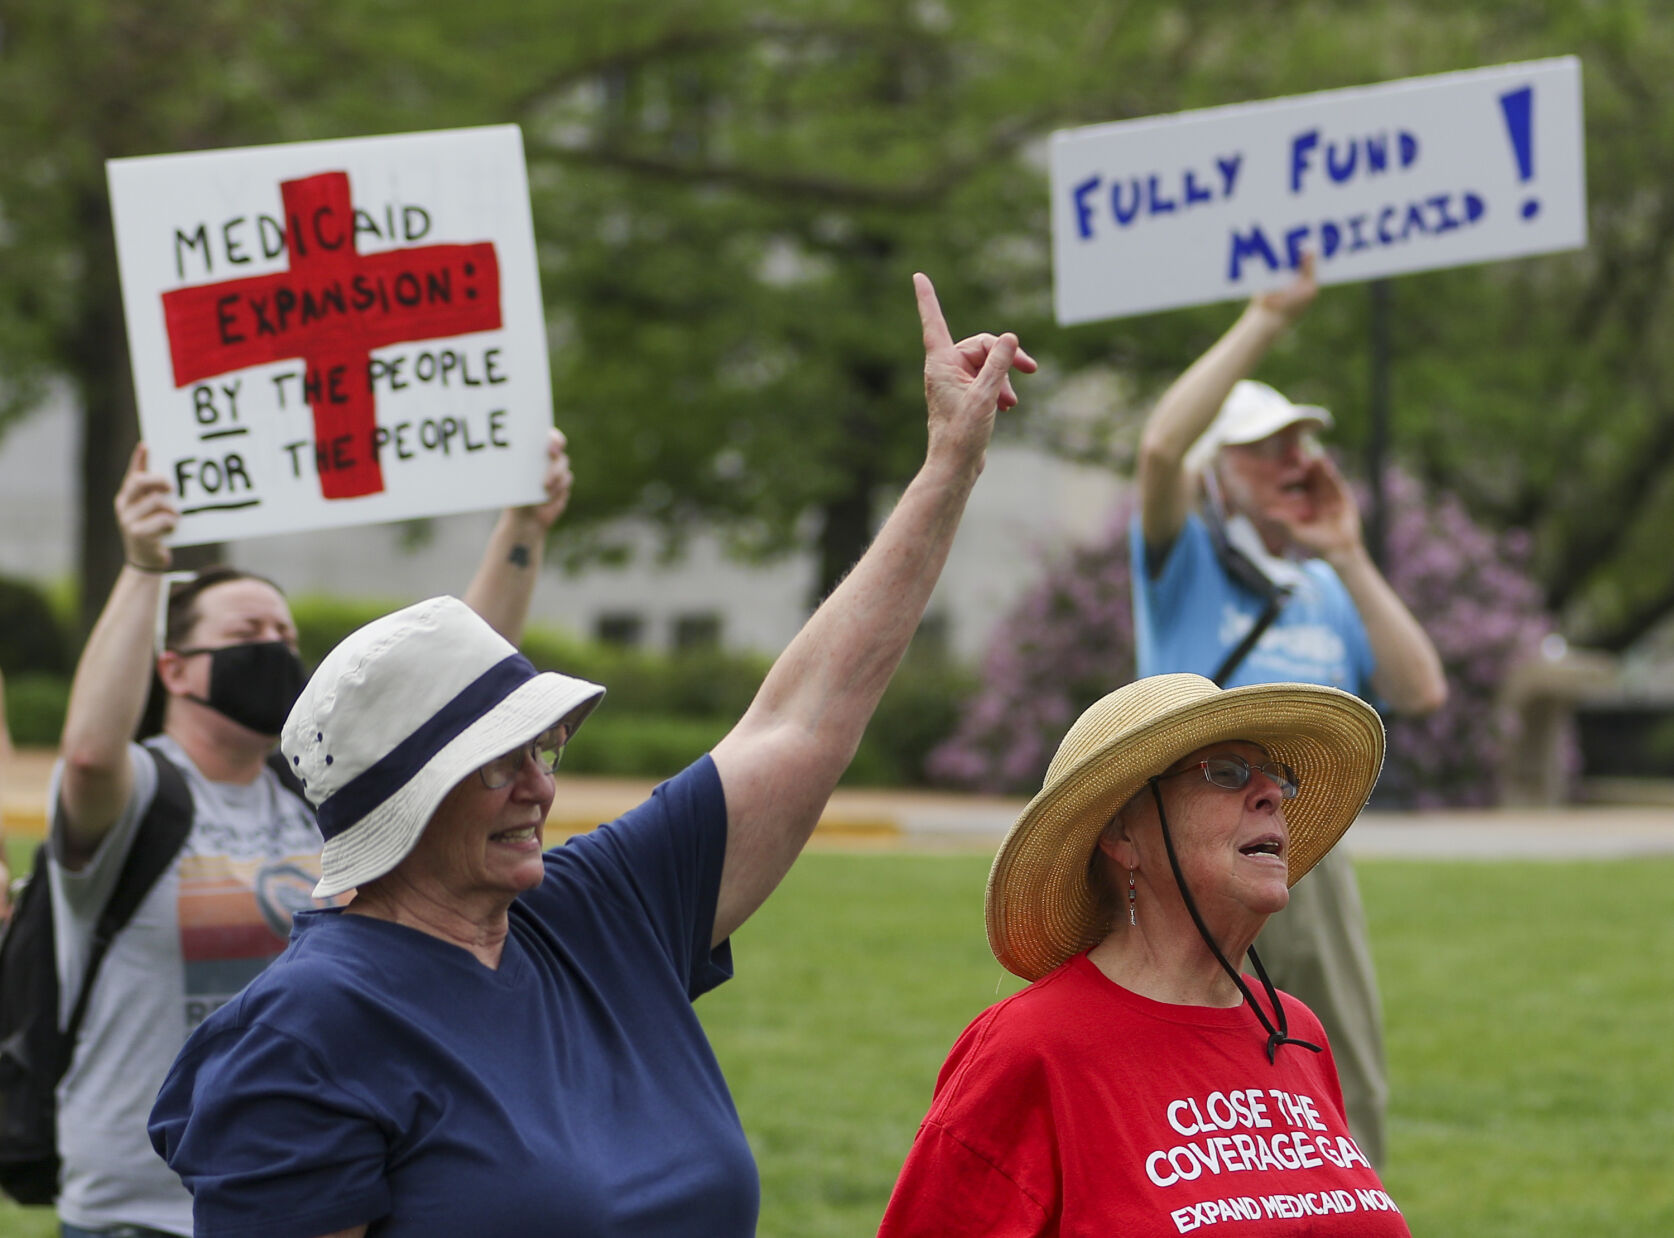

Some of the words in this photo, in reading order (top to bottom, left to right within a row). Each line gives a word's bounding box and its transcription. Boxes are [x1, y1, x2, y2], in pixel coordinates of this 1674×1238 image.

[1072, 150, 1243, 242] FULLY
[1289, 128, 1420, 195] FUND
[173, 204, 433, 280] MEDICAID
[1227, 192, 1488, 283] MEDICAID
[216, 261, 478, 345] EXPANSION:
[192, 379, 242, 426] BY
[271, 365, 351, 411] THE
[367, 348, 508, 394] PEOPLE
[174, 452, 254, 500] FOR
[282, 435, 357, 479] THE
[370, 409, 511, 464] PEOPLE
[1166, 1088, 1273, 1137] CLOSE
[1268, 1089, 1329, 1132] THE
[1145, 1131, 1324, 1188] COVERAGE
[1315, 1135, 1373, 1170] GA
[1170, 1196, 1262, 1235] EXPAND
[1259, 1189, 1357, 1220] MEDICAID
